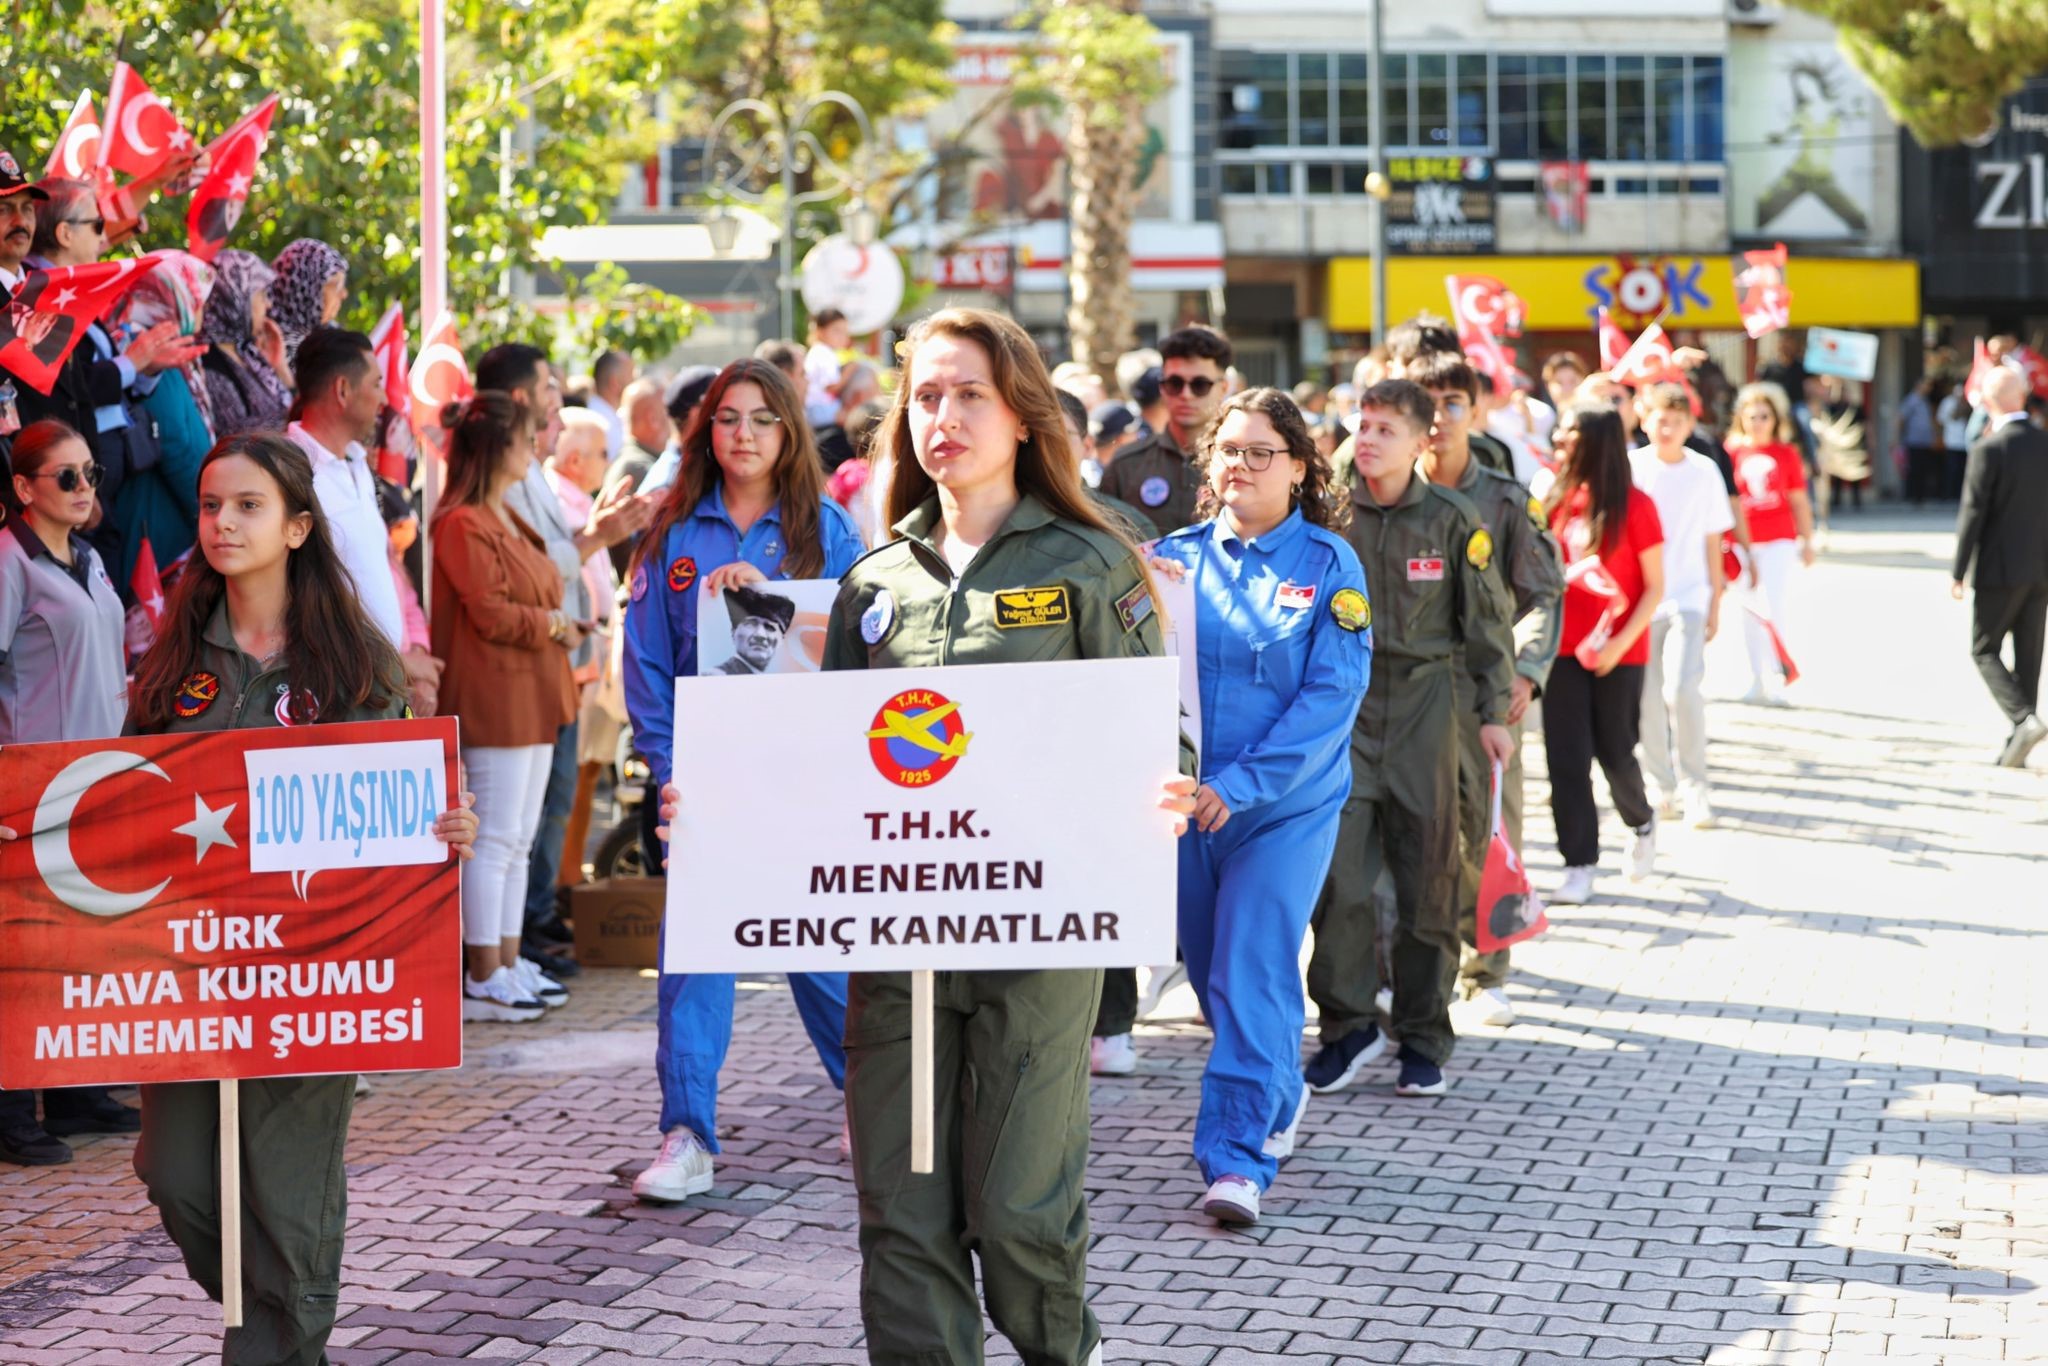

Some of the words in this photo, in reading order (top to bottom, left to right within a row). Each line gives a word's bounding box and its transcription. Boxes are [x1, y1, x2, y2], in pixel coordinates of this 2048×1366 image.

[895, 691, 935, 707] T.H.K.
[900, 769, 931, 784] 1925
[256, 774, 303, 844] 100
[312, 768, 437, 857] YAŞINDA
[864, 810, 990, 840] T.H.K.
[809, 860, 1044, 894] MENEMEN
[168, 910, 284, 952] TÜRK
[734, 917, 856, 955] GENÇ
[871, 911, 1120, 946] KANATLAR
[63, 970, 183, 1009] HAVA
[200, 958, 395, 1002] KURUMU
[34, 1015, 252, 1060] MENEMEN
[269, 997, 424, 1058] ŞUBESİ
